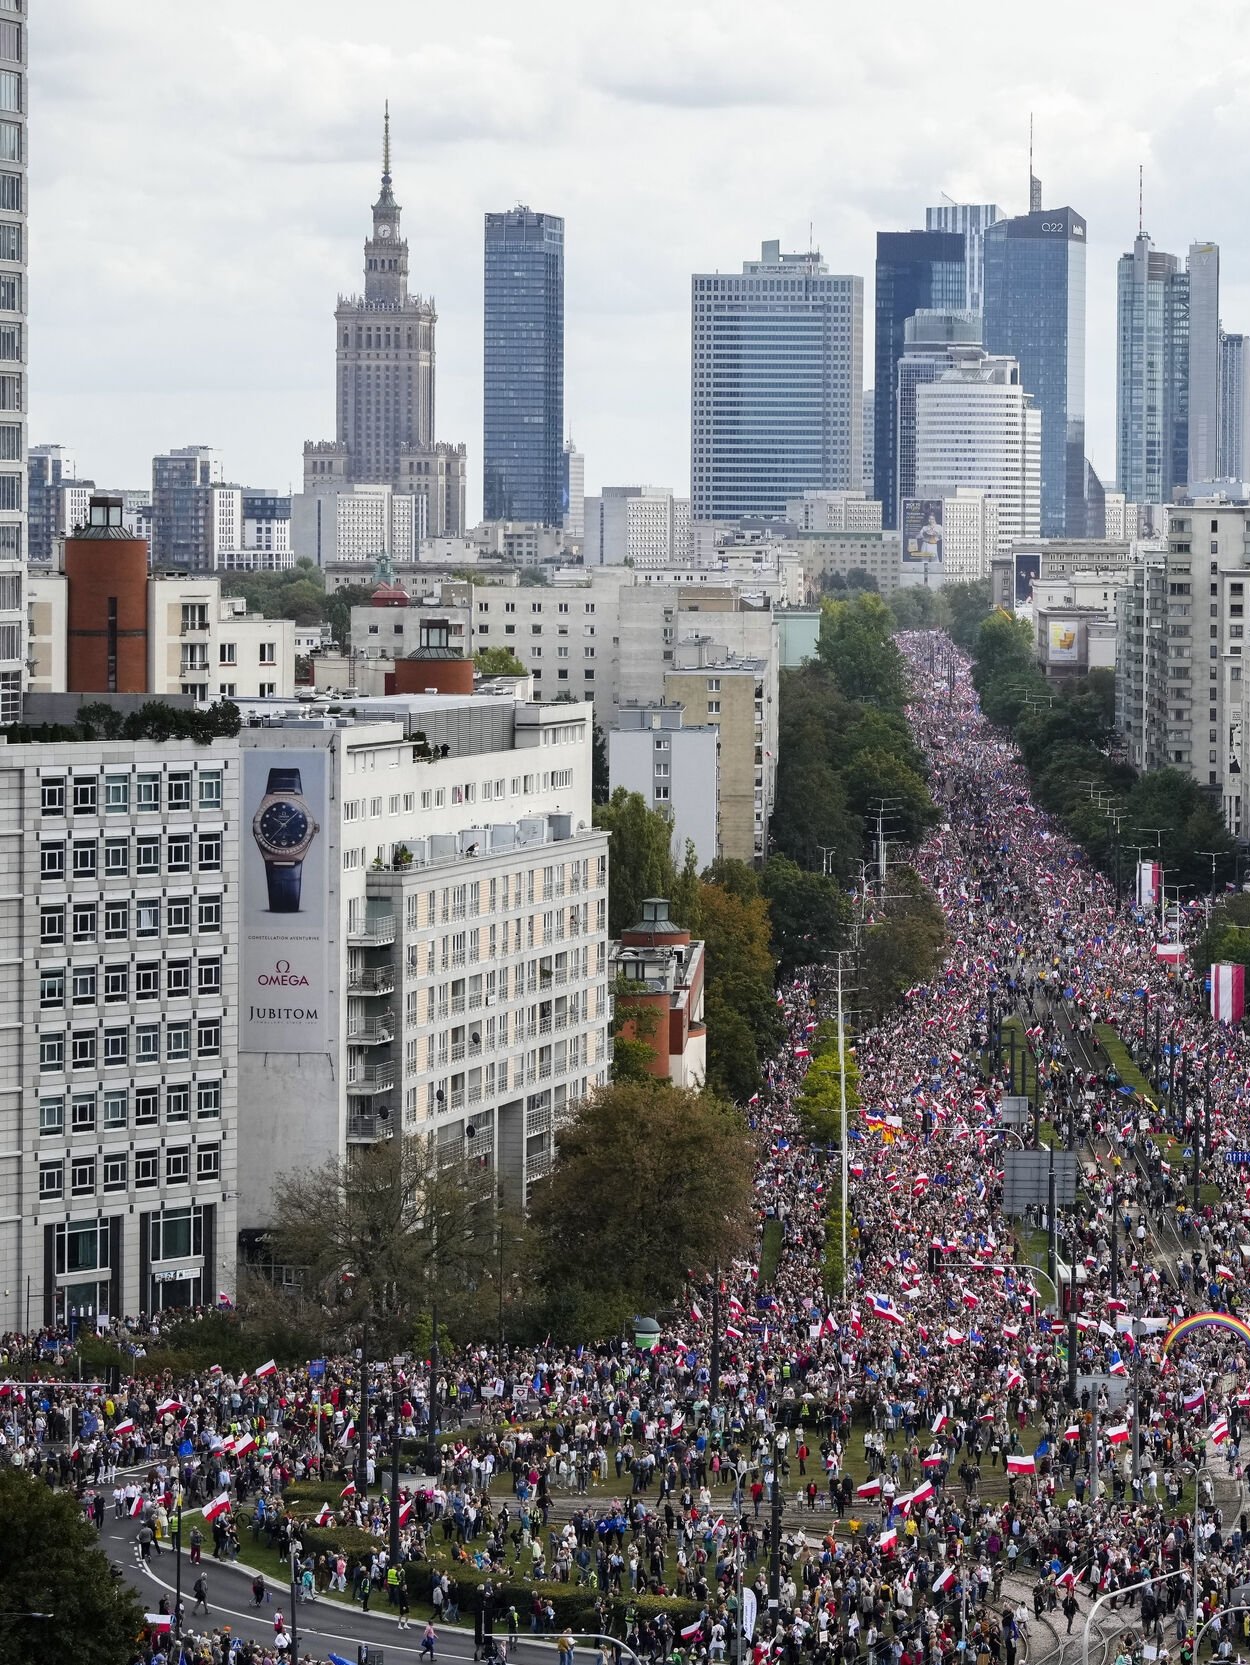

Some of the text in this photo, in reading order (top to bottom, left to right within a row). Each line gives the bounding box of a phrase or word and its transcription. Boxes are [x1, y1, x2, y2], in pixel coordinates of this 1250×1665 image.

[1041, 222, 1063, 232] Q22
[1195, 255, 1208, 265] EY
[257, 974, 309, 986] OMEGA
[249, 1006, 318, 1021] JUBITOM
